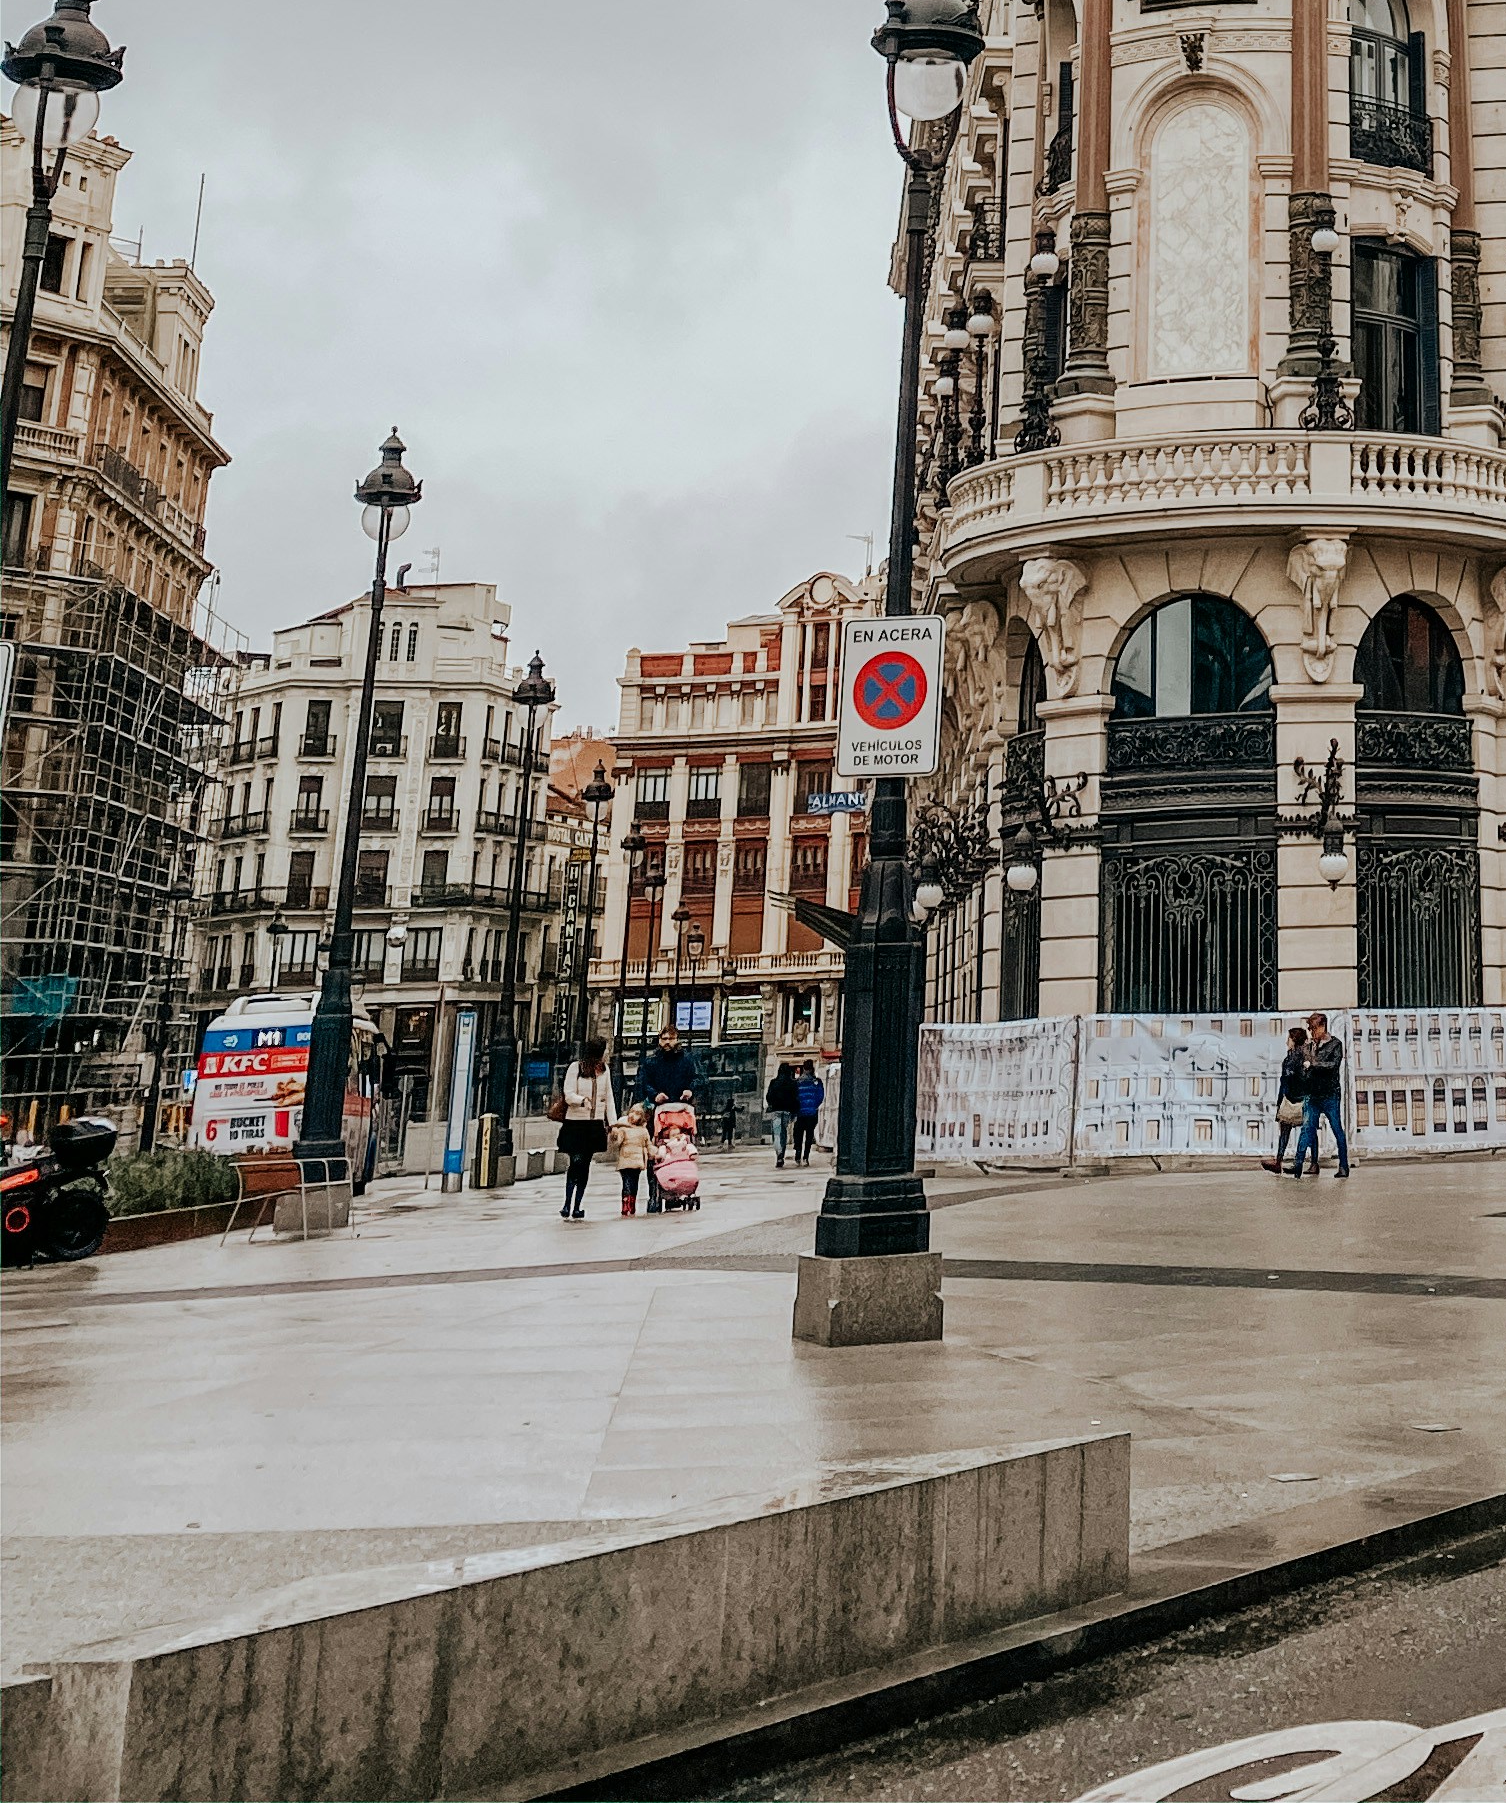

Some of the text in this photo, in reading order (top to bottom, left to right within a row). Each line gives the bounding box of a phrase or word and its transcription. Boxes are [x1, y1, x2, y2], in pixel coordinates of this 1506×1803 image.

[853, 628, 932, 643] EN ACERA
[851, 739, 922, 752] VEHÍCULOS
[853, 754, 919, 766] DE MOTOR
[220, 1053, 268, 1074] KFC
